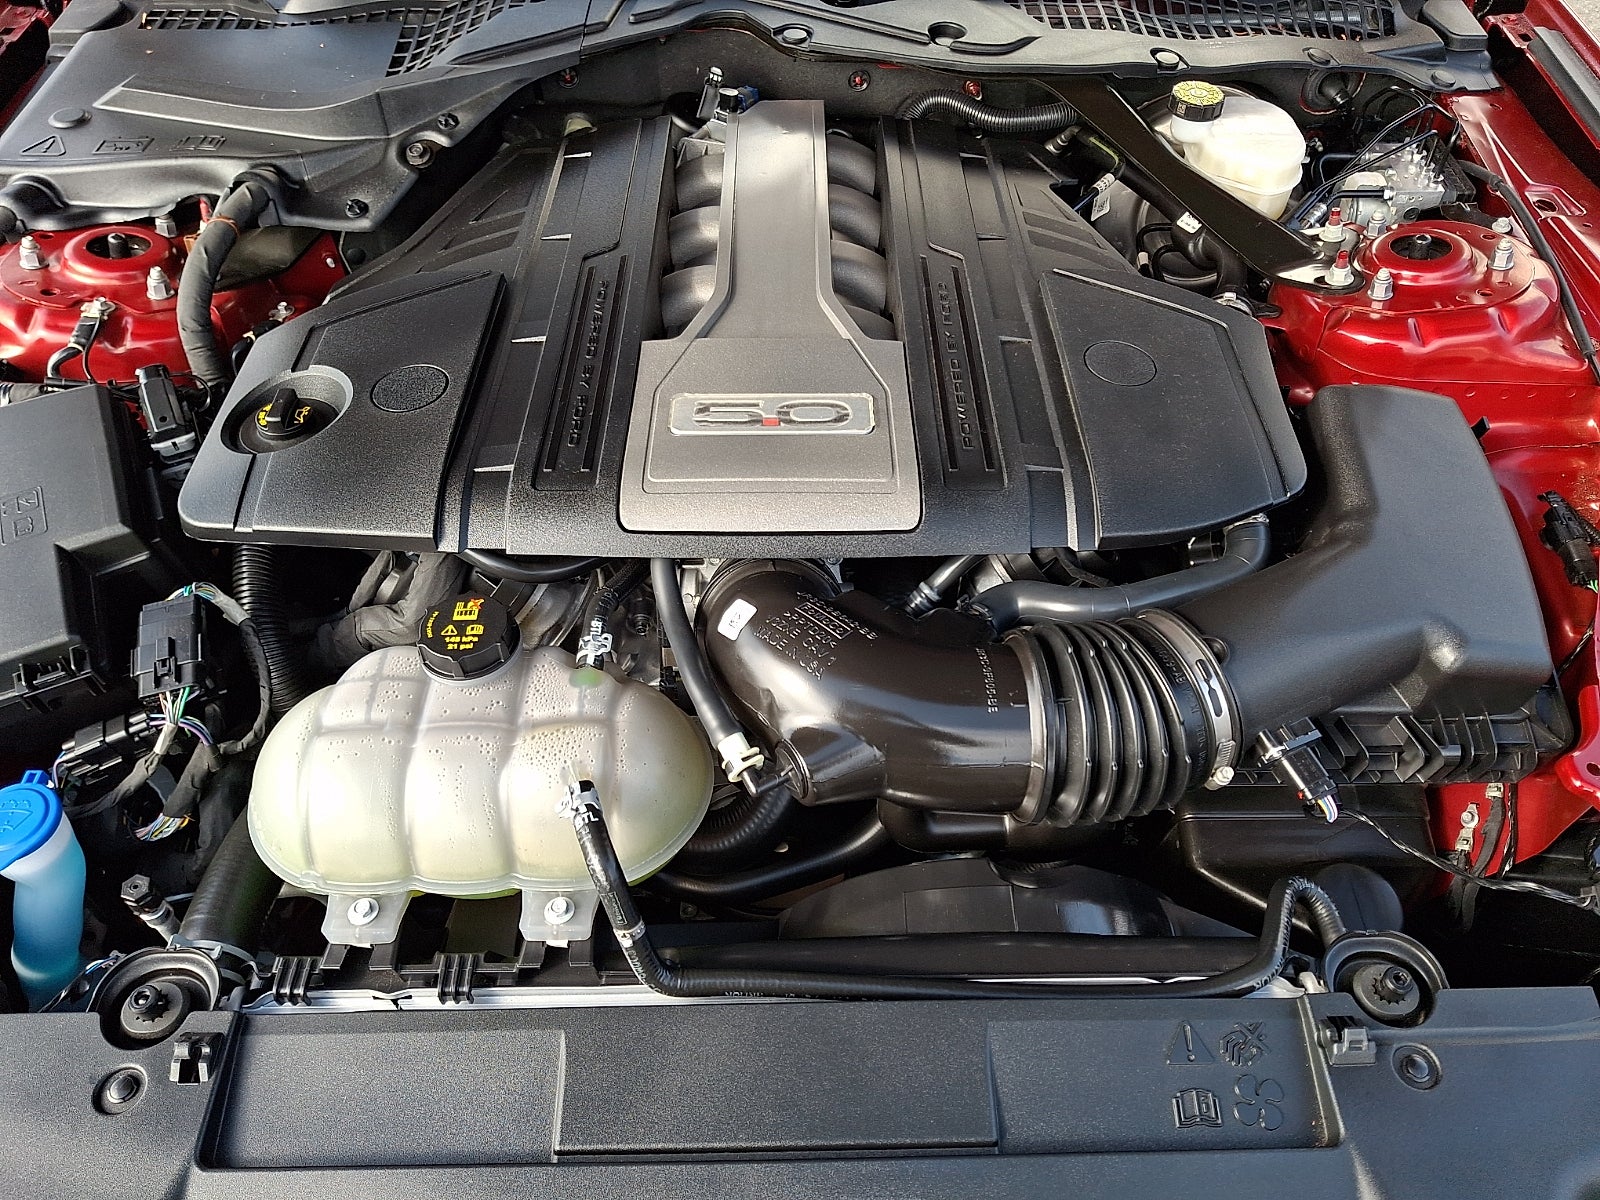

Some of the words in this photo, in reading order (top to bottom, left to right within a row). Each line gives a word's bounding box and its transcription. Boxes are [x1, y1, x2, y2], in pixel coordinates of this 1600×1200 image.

[585, 280, 608, 359] POWERED
[938, 282, 953, 325] FORD
[944, 331, 958, 353] BY
[579, 364, 595, 389] BY
[568, 394, 588, 447] FORD
[692, 400, 852, 427] 5.0
[950, 358, 974, 450] POWERED
[800, 603, 844, 636] FoMoCo
[754, 625, 788, 651] MADE
